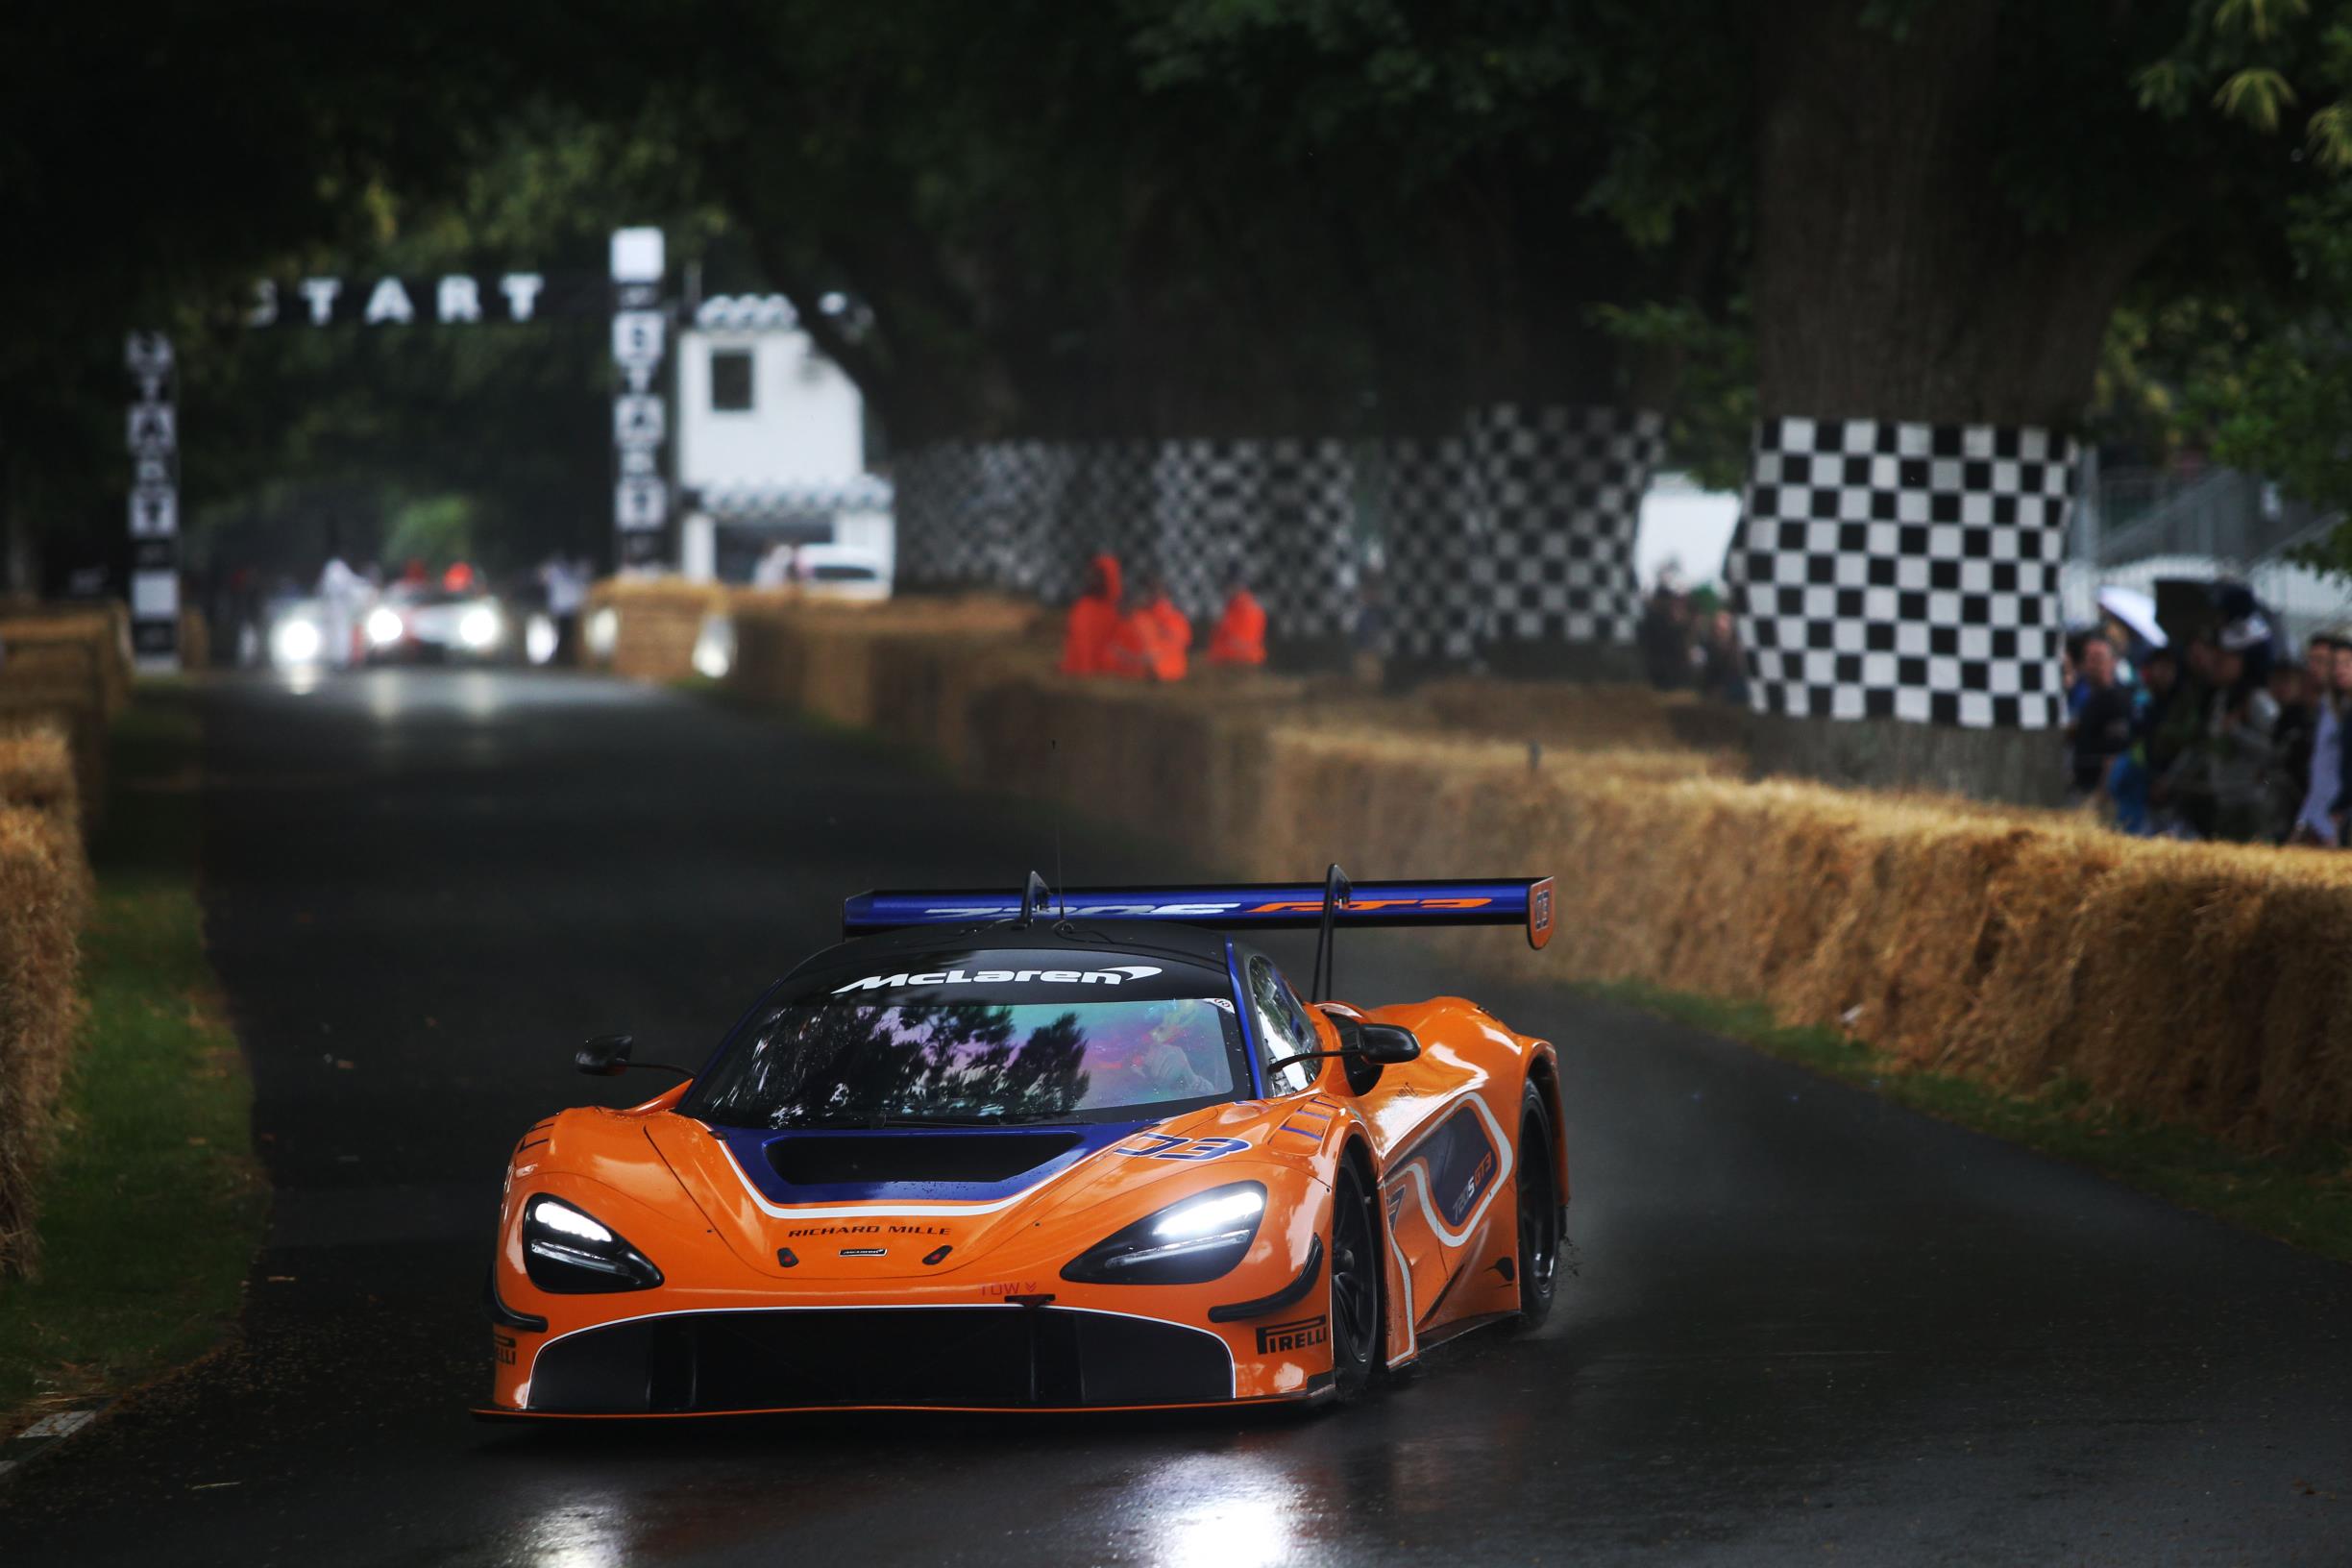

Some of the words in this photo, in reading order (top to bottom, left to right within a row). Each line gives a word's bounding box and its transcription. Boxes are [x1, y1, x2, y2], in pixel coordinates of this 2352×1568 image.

[831, 967, 1163, 993] McLaren
[788, 1225, 880, 1237] RICHARD
[888, 1225, 951, 1236] MILLE
[980, 1282, 1020, 1296] TOW
[1256, 1314, 1327, 1355] PIRELLI
